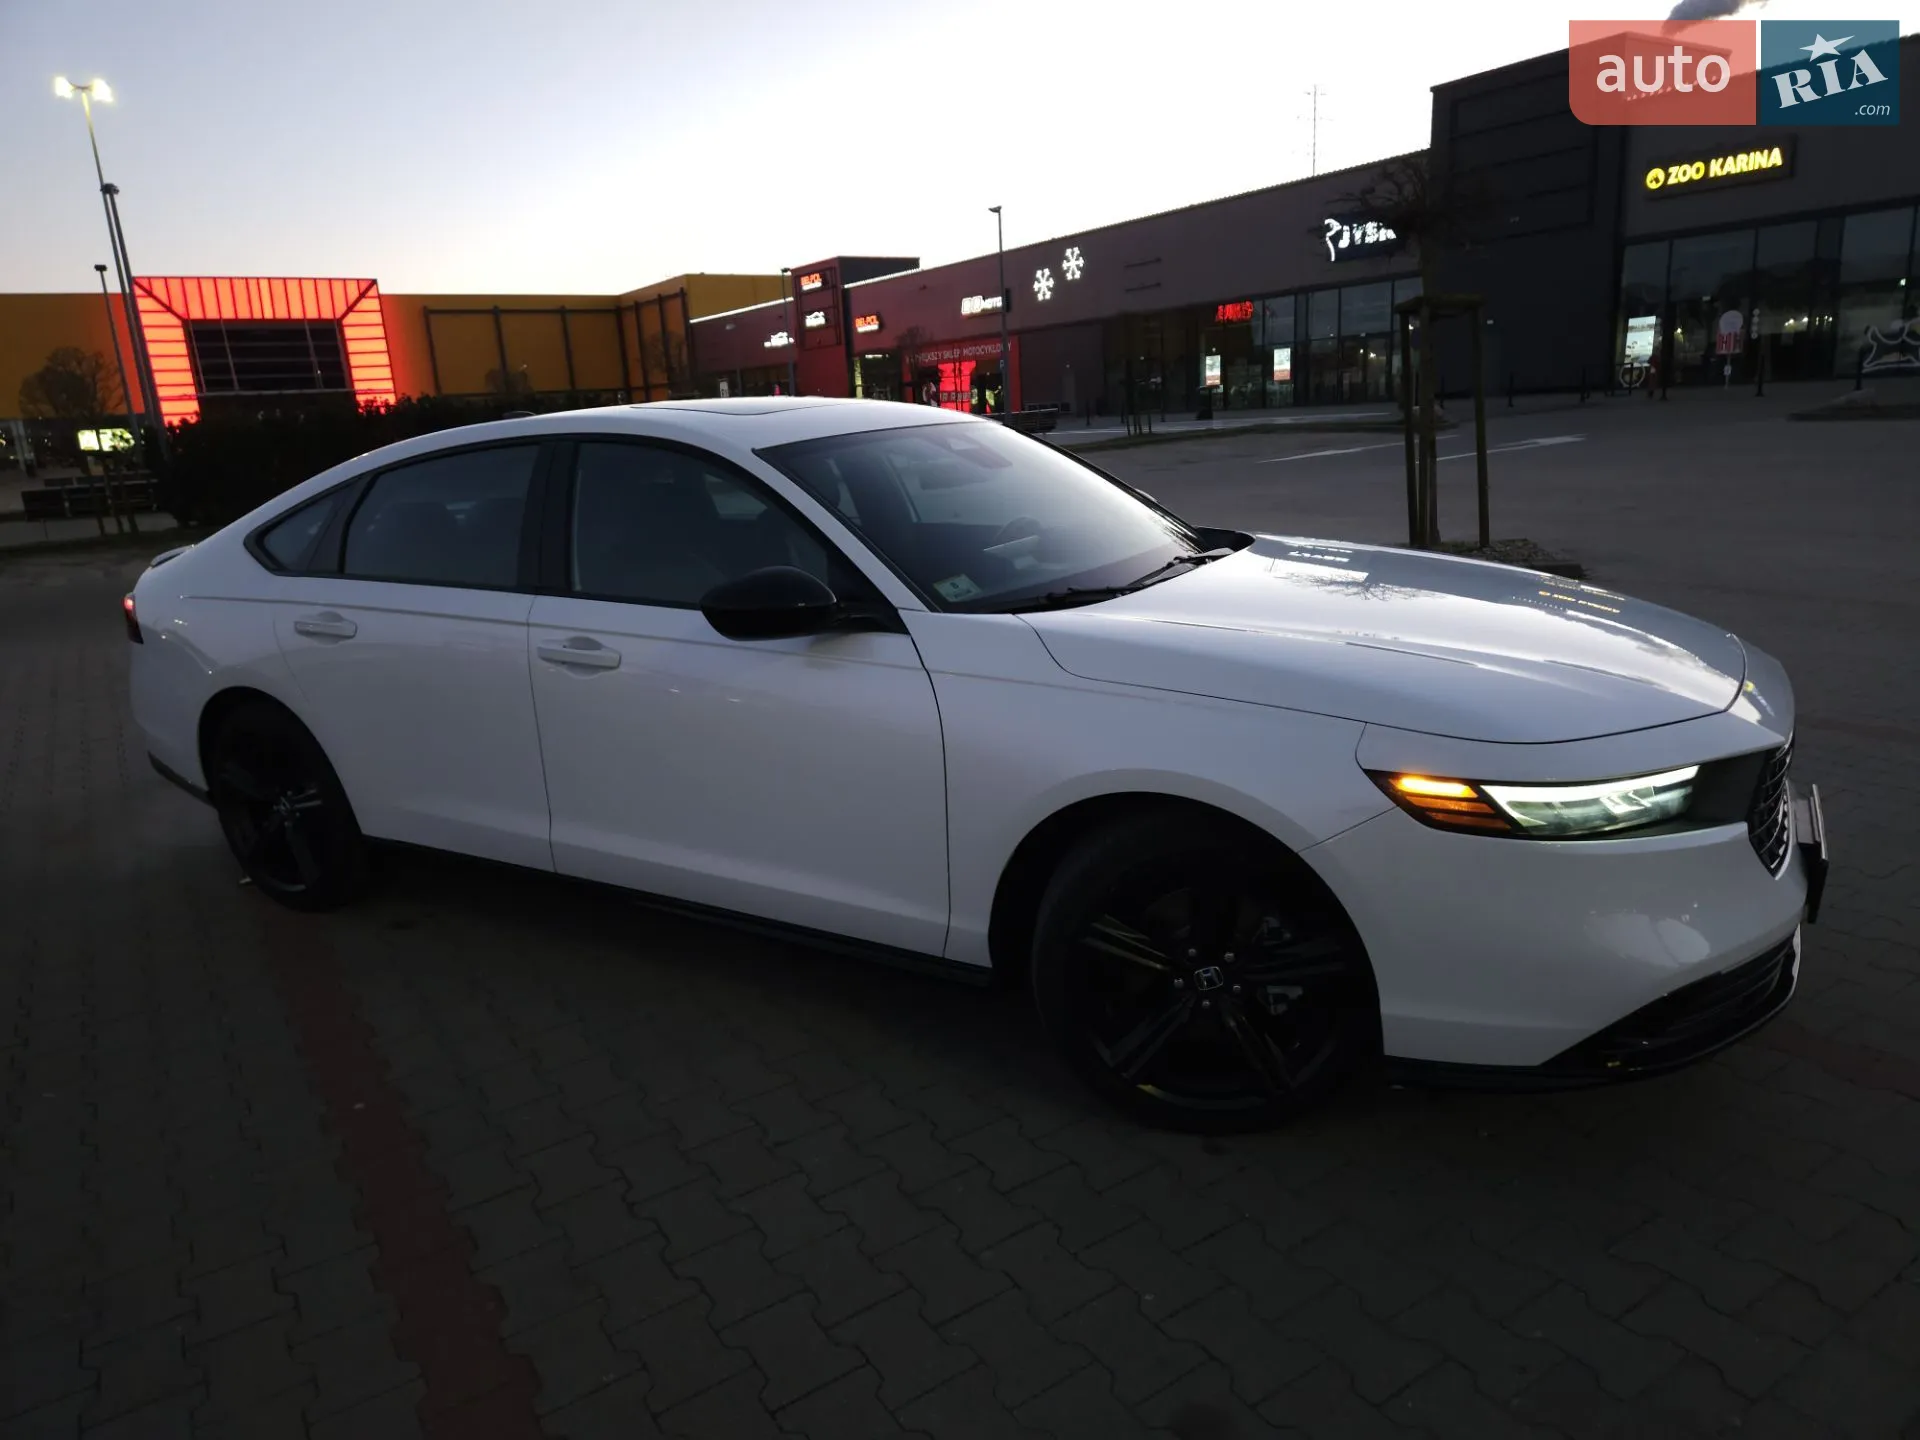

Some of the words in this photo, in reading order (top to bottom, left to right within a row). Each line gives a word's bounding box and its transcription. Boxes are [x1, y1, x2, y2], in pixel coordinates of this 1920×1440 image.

[1667, 161, 1705, 185] ZOO
[1709, 148, 1783, 178] KARINA
[963, 340, 1012, 357] MOTOCYKLOY
